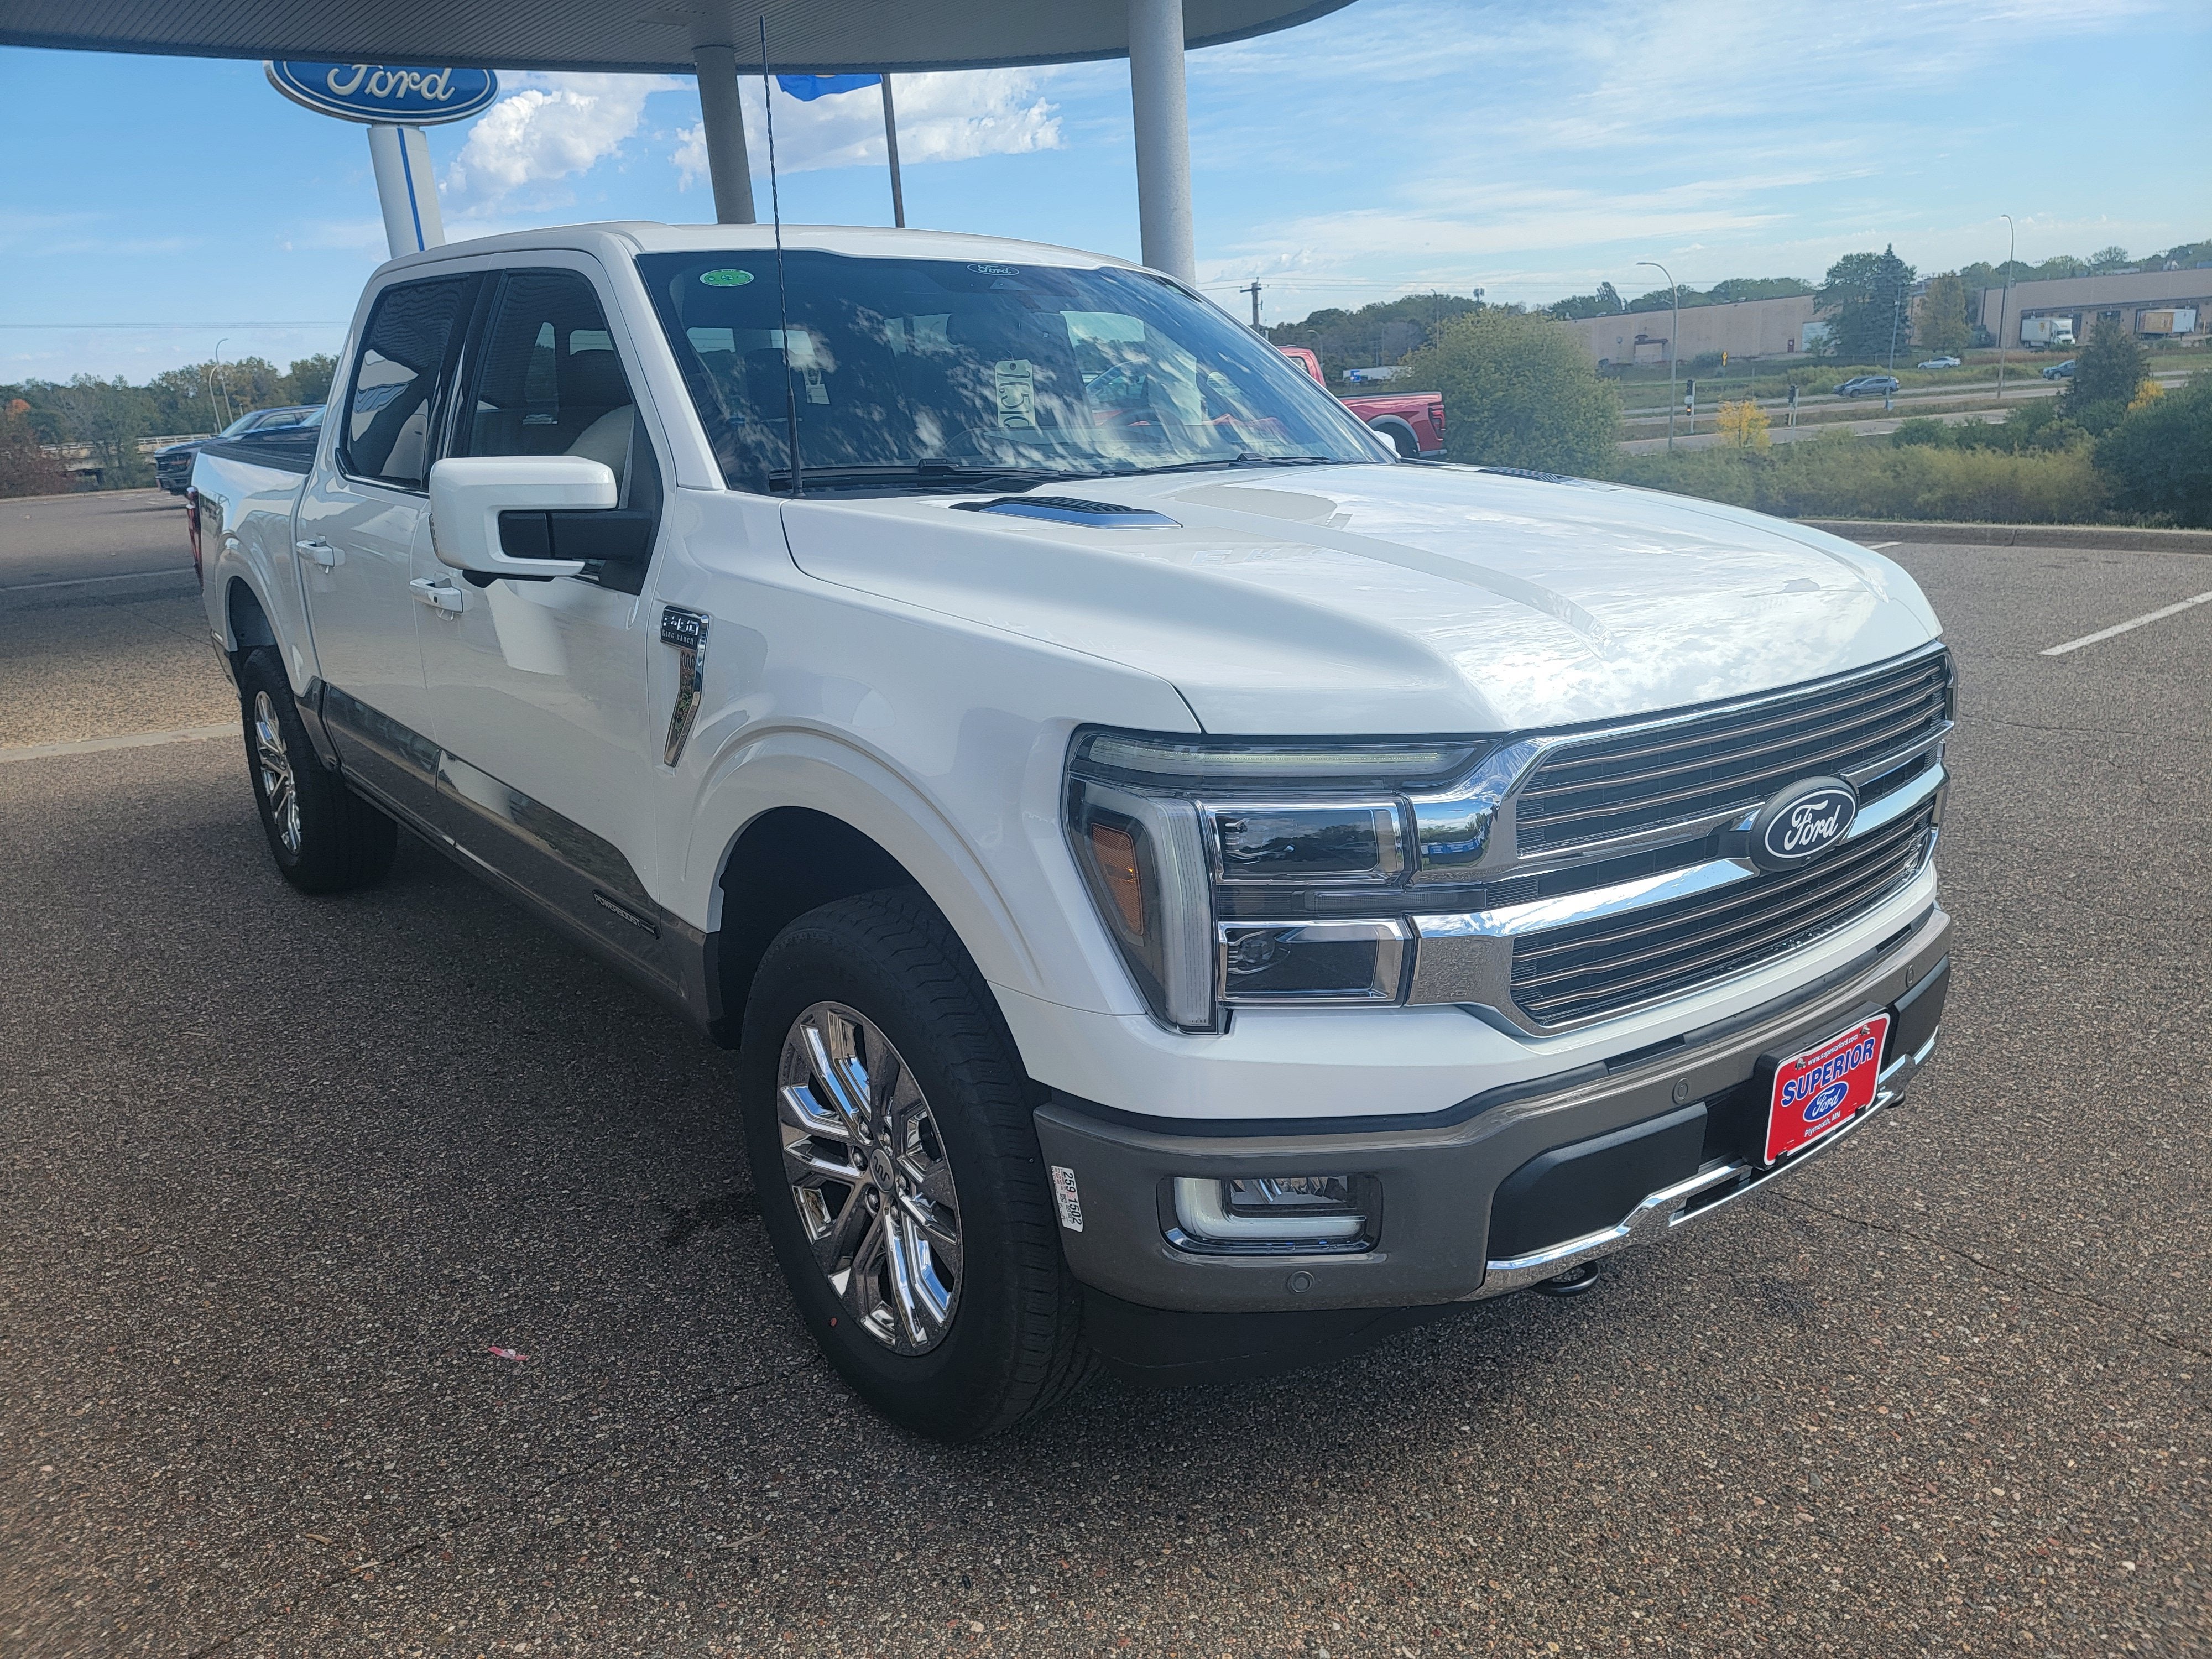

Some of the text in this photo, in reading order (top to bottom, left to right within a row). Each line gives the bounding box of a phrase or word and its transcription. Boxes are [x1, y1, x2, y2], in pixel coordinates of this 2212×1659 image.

[327, 64, 455, 102] Ford
[978, 265, 1011, 274] Ford
[662, 629, 694, 645] KING RANCH
[1784, 799, 1841, 851] Ford
[1808, 1034, 1859, 1066] www.superiorford.com
[1781, 1037, 1875, 1107] SUPERIOR
[1812, 1088, 1840, 1117] Ford
[1804, 1111, 1841, 1138] Plymouth, MN
[1063, 1171, 1076, 1193] 259
[1068, 1198, 1082, 1225] 1502
